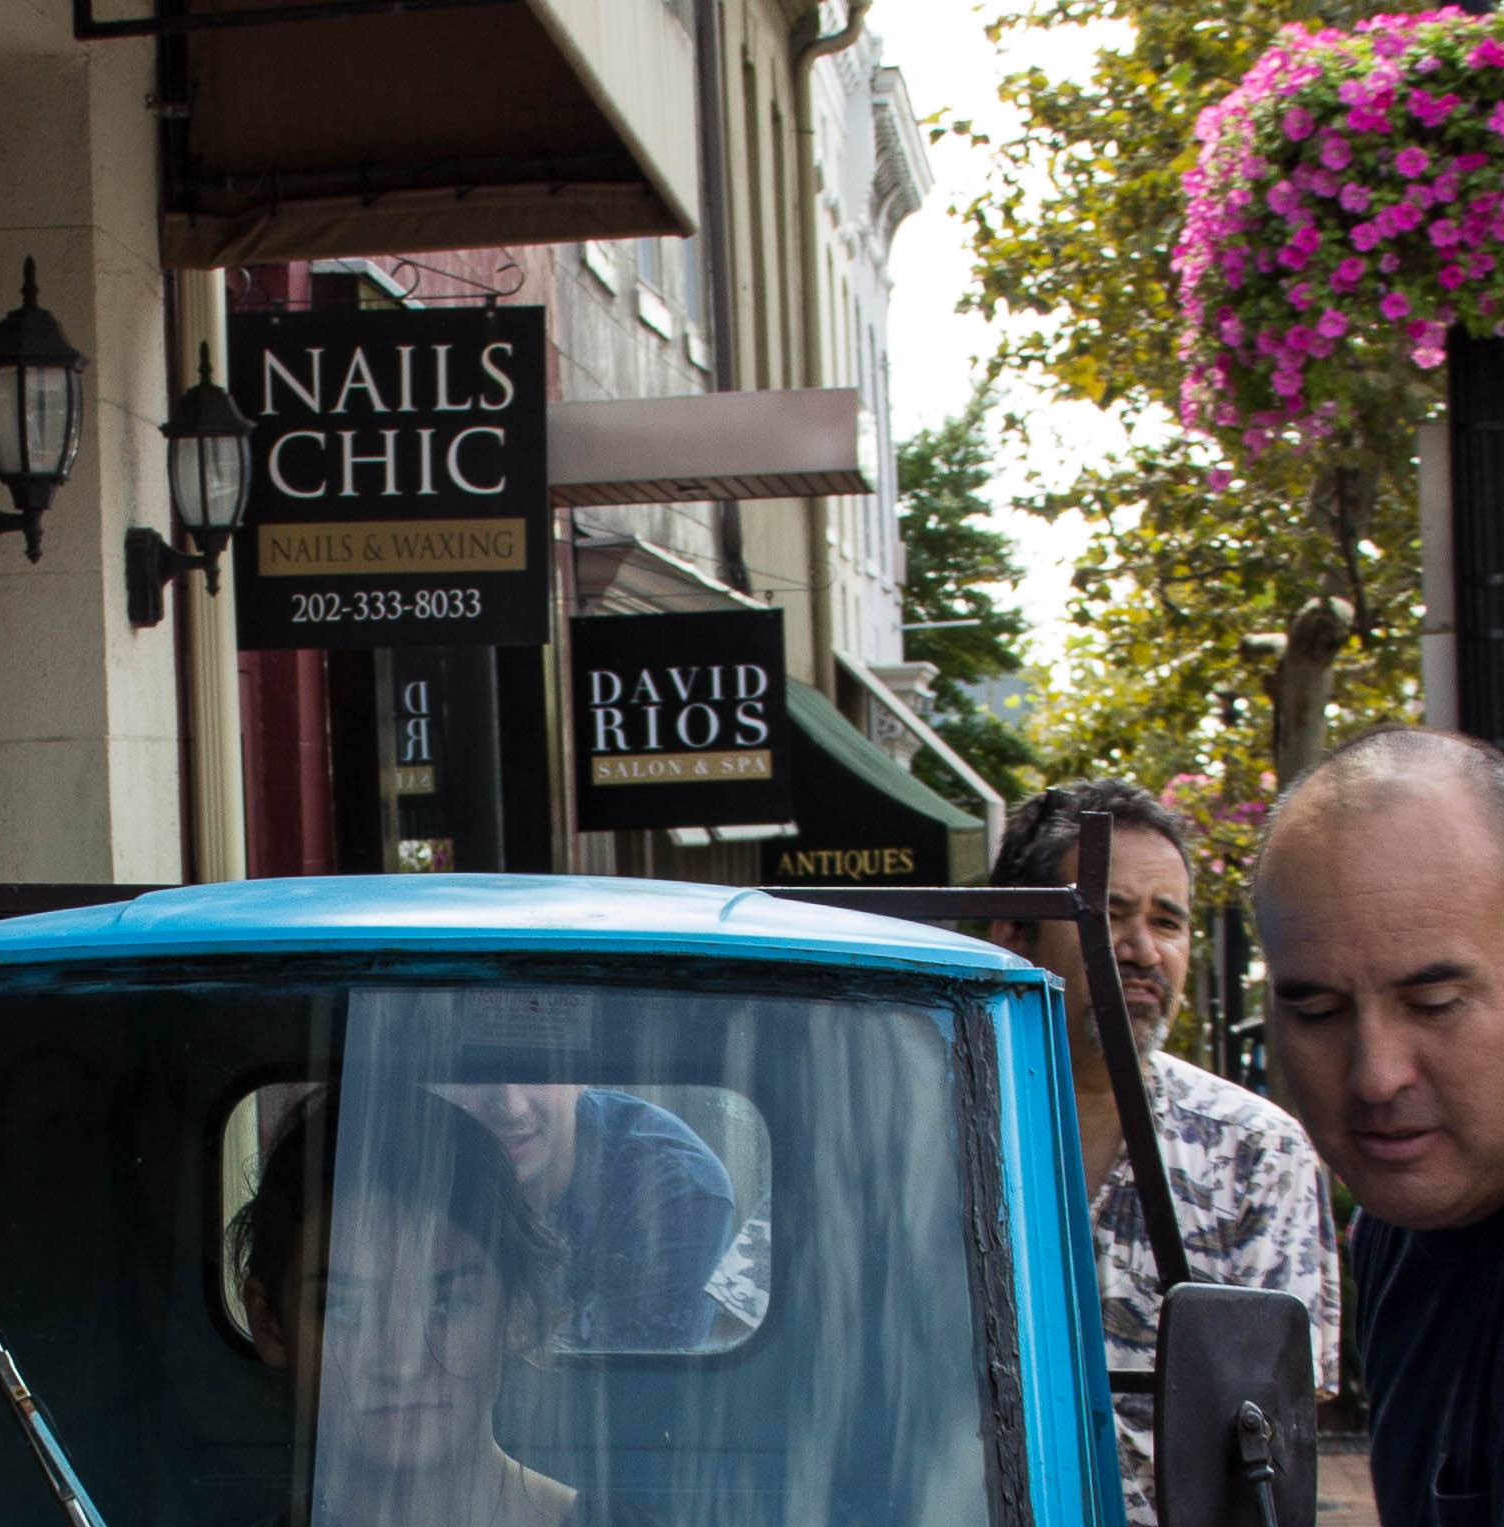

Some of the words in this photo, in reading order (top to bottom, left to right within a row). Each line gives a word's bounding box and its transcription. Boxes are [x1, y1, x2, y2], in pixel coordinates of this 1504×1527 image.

[258, 342, 515, 416] NAILS
[268, 426, 506, 498] CHIC
[269, 534, 354, 563] NAILS
[362, 533, 384, 561] &
[392, 529, 515, 560] WAXING
[291, 588, 482, 622] 202-333-8033
[588, 663, 769, 705] DAVID
[589, 701, 769, 751] RIOS
[597, 758, 682, 779] SALON
[694, 758, 709, 775] &
[720, 755, 767, 774] SPA
[778, 848, 914, 881] ANTIQUES
